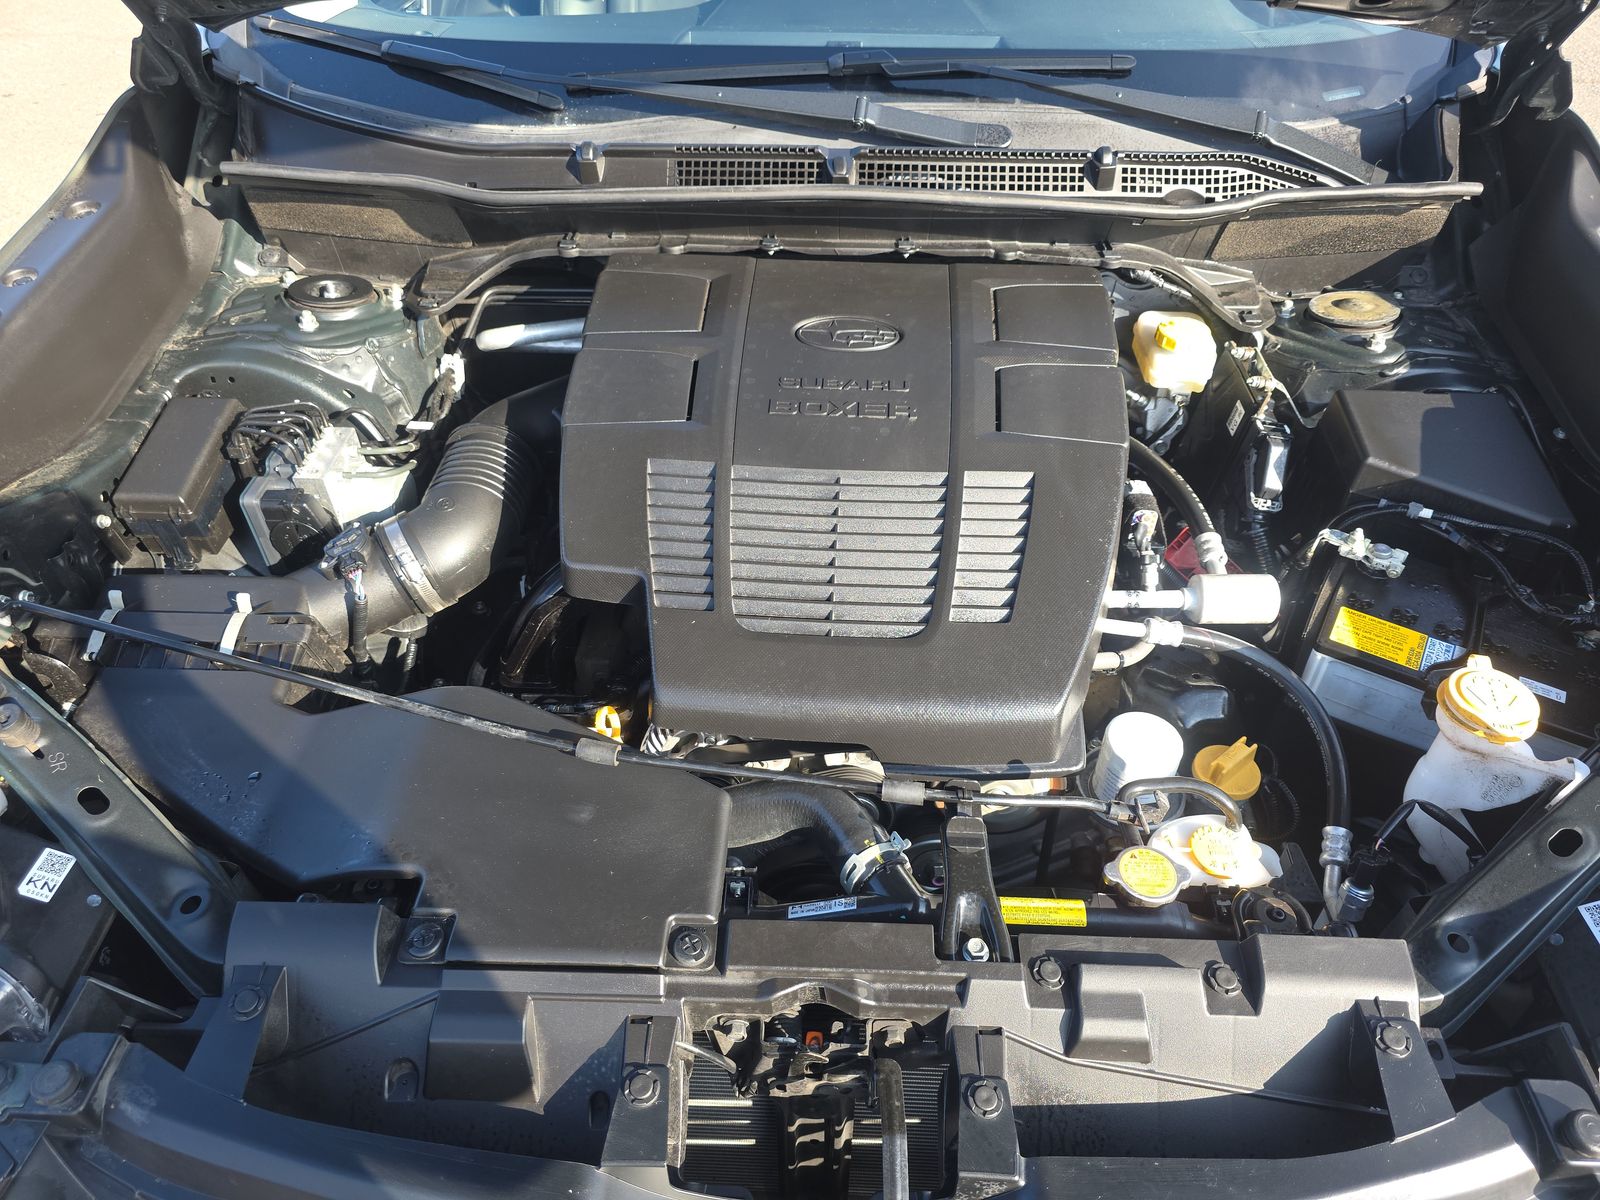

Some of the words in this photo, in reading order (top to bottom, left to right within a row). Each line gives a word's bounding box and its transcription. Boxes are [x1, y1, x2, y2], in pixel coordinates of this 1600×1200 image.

[778, 376, 910, 393] SUBARU
[767, 398, 918, 420] BOXER
[48, 751, 68, 774] SR
[25, 876, 57, 893] KN
